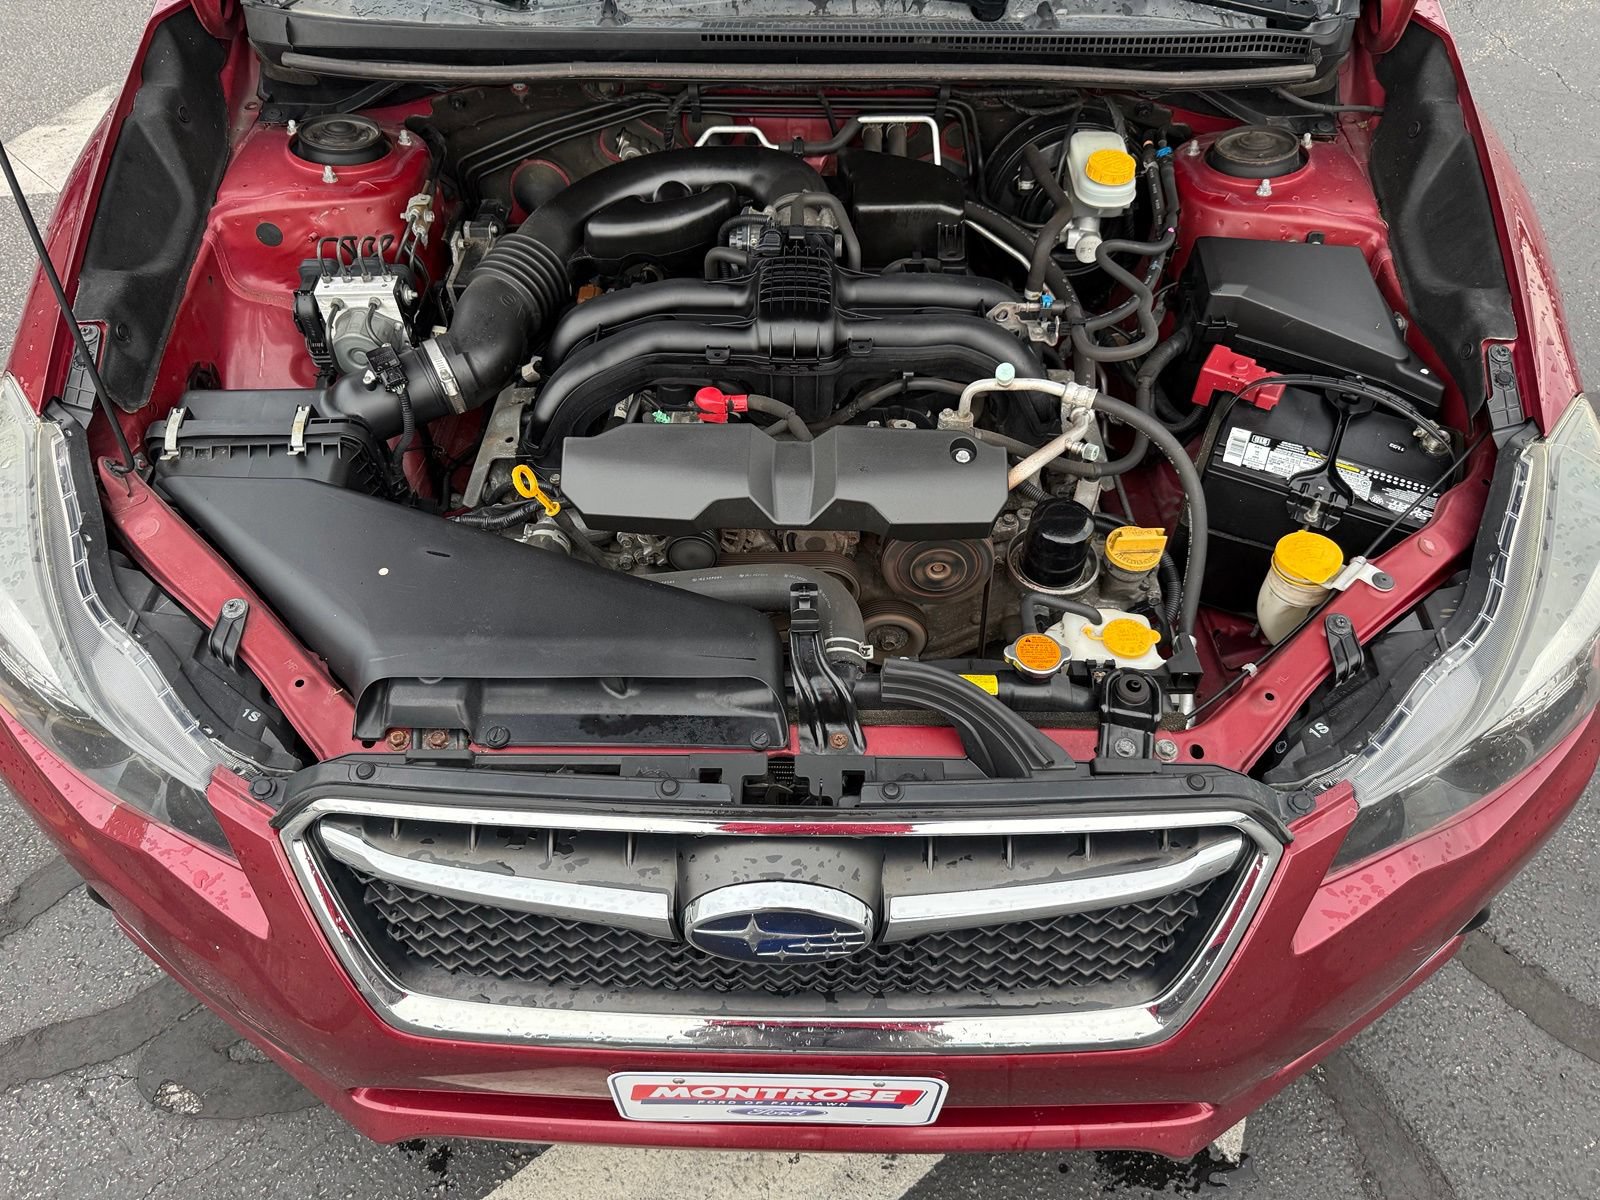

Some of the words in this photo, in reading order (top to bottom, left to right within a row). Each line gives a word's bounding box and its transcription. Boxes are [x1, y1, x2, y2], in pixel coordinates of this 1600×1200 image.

[242, 708, 261, 722] 1S
[1308, 722, 1330, 739] 1S
[649, 1086, 901, 1102] MONTROSE
[747, 1107, 807, 1118] Ford
